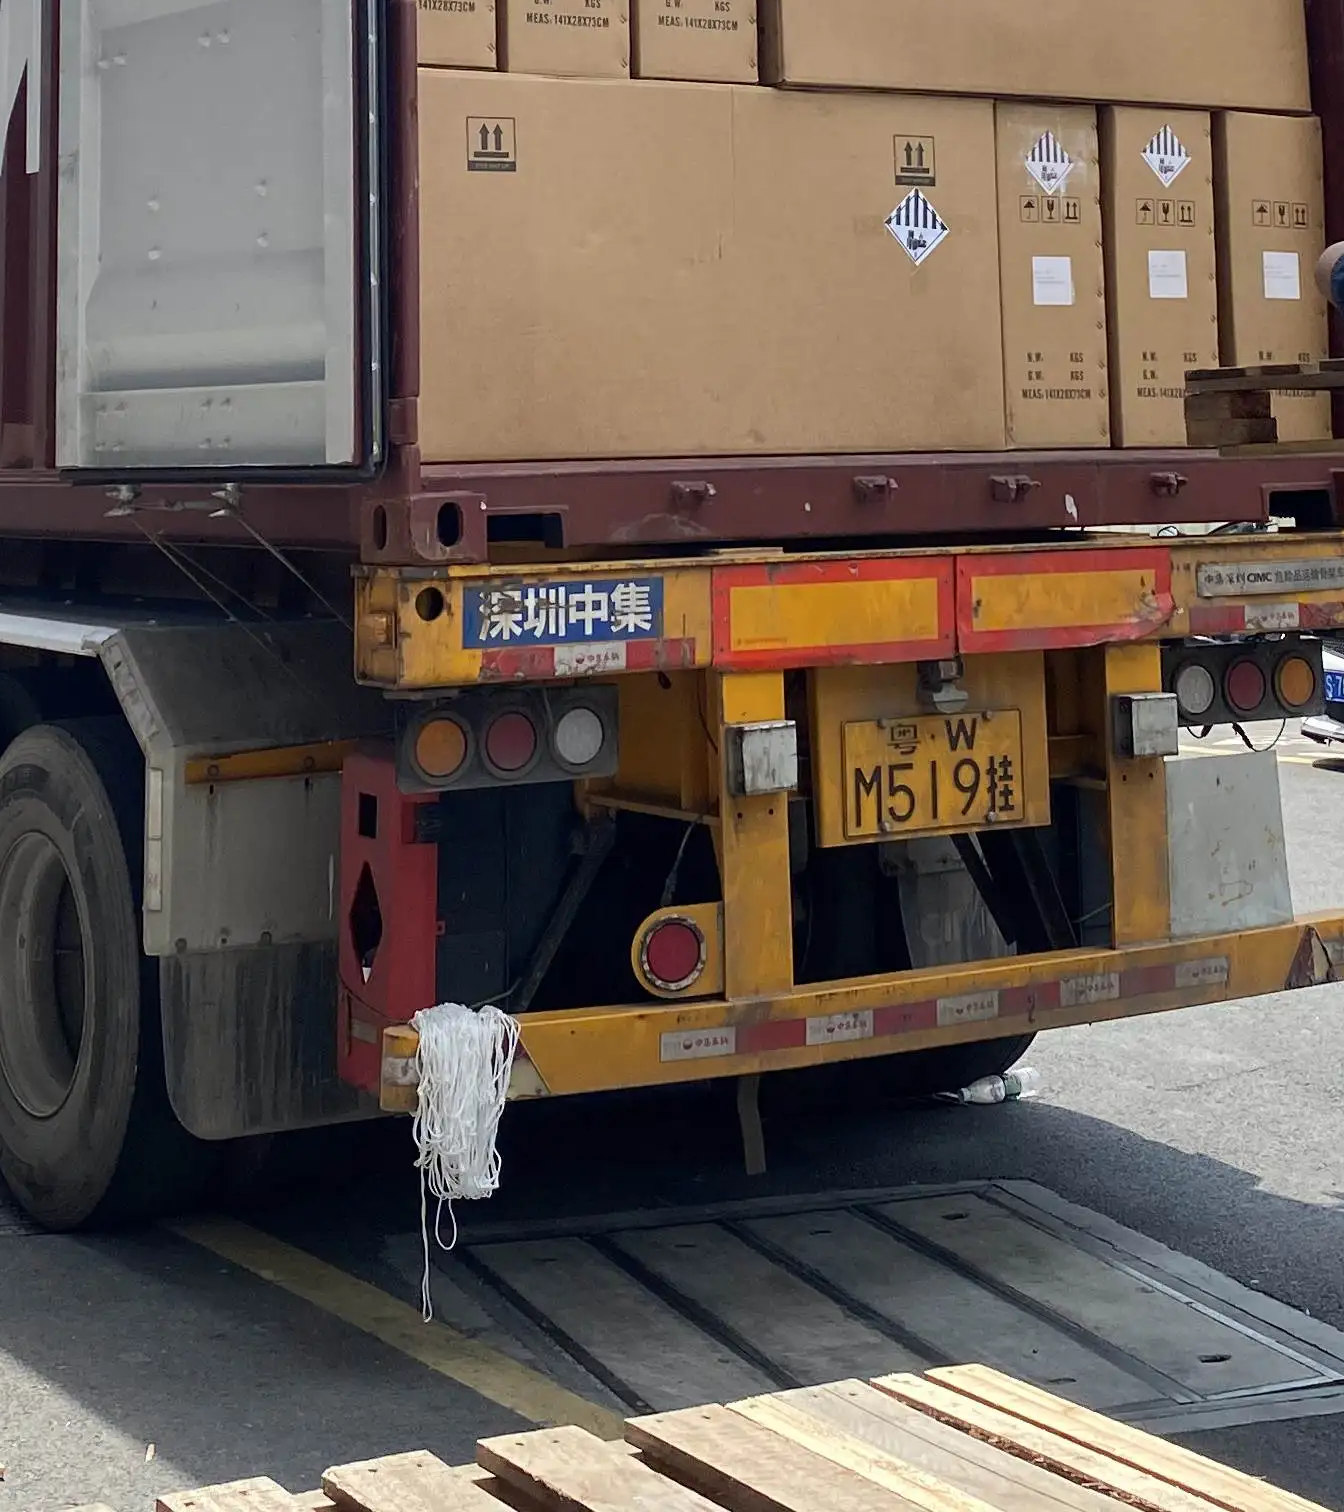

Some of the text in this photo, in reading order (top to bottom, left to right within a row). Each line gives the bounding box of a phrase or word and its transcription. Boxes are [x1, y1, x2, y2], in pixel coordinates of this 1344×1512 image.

[714, 1, 731, 13] KGS
[554, 13, 610, 28] 141X28X73CM
[685, 16, 739, 31] 141X28X73CM
[478, 582, 652, 640] 深圳中集
[855, 754, 1016, 829] M519挂
